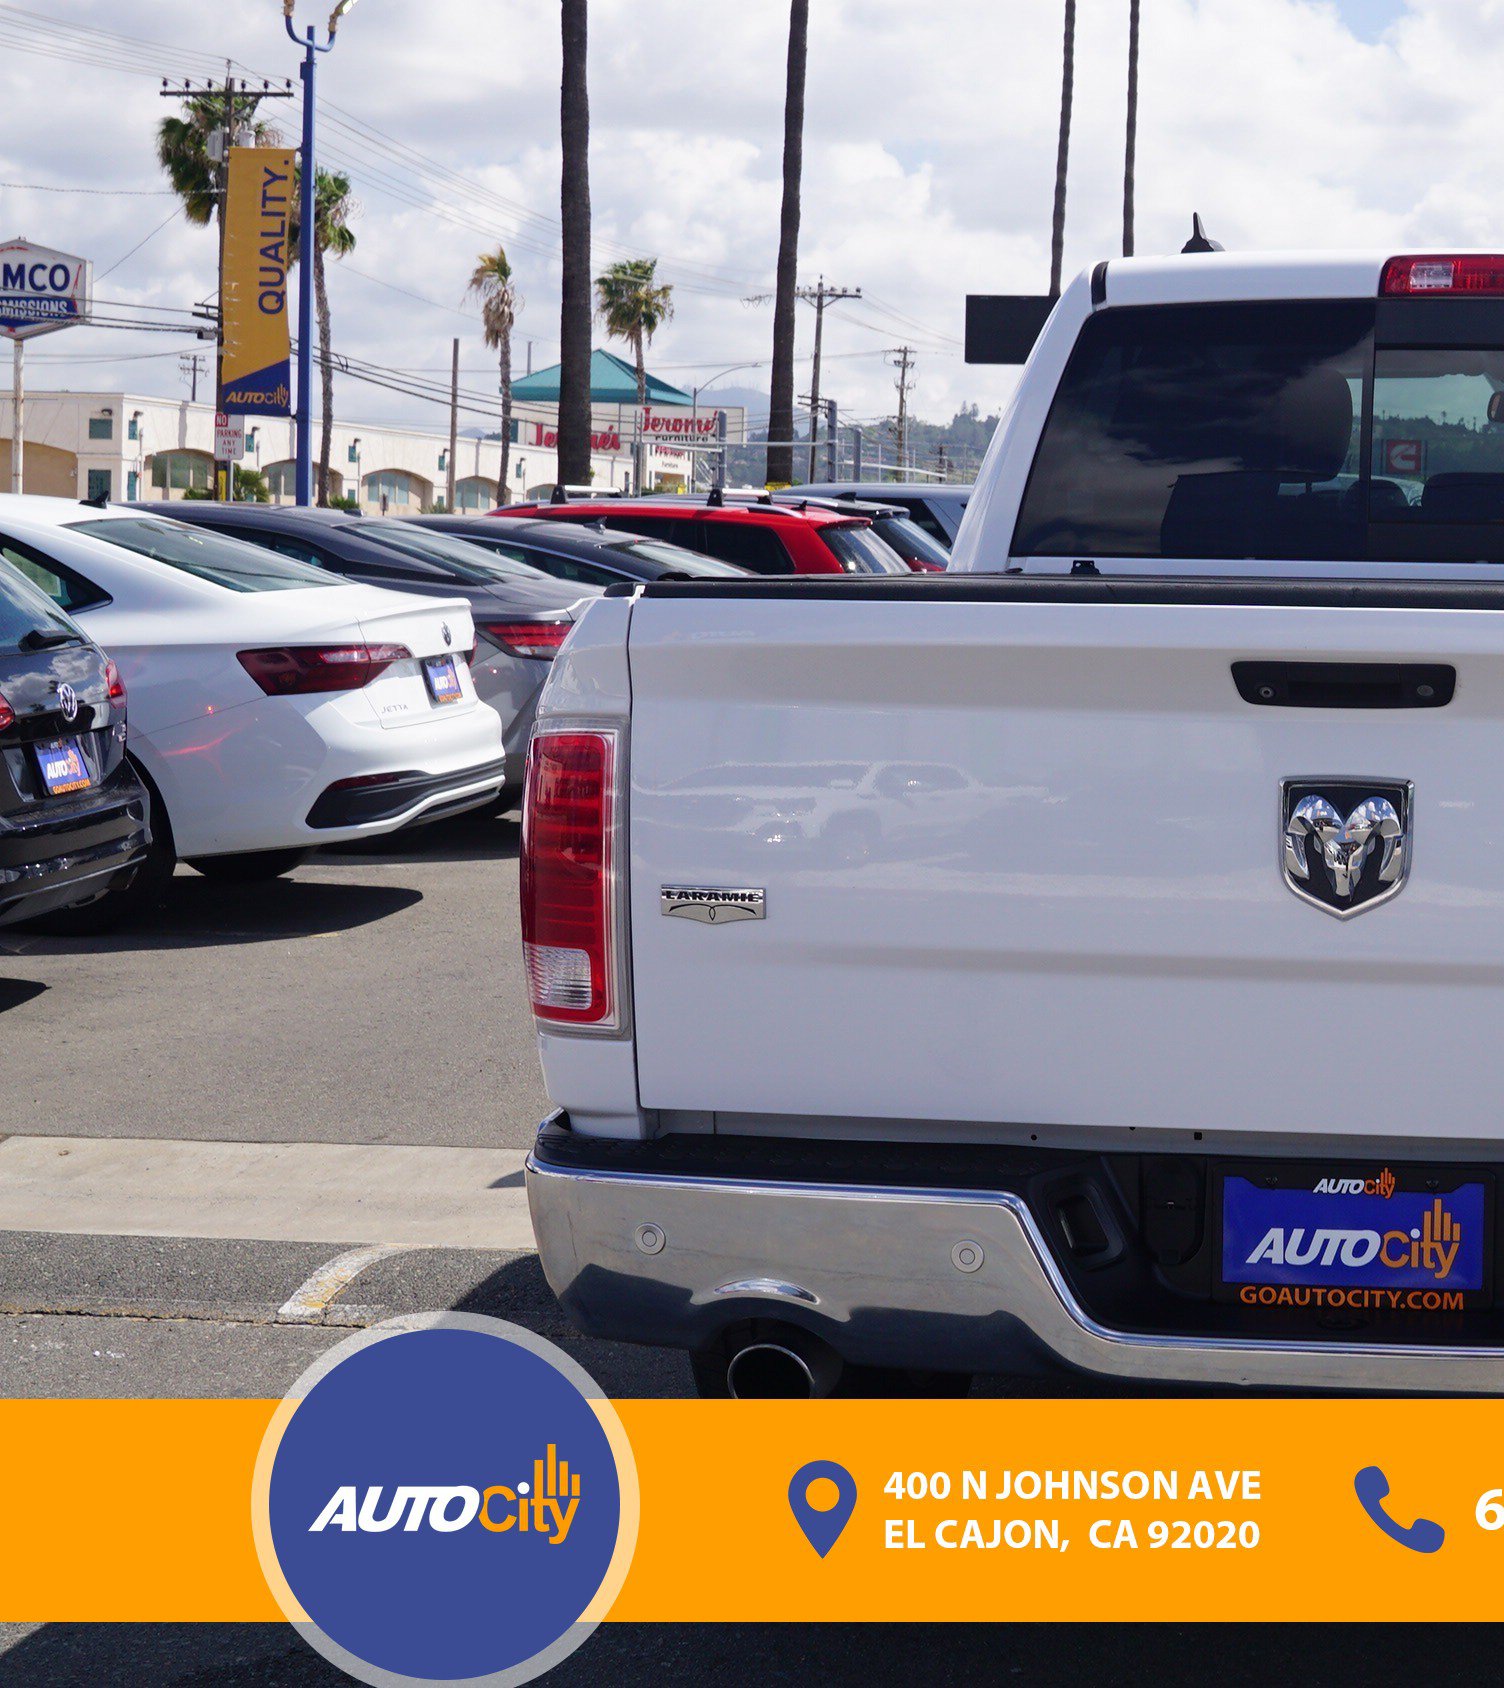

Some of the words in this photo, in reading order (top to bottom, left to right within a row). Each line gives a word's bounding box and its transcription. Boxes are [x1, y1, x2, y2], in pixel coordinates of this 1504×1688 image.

[258, 159, 290, 315] QUALITY.
[216, 415, 228, 427] NO
[382, 703, 409, 714] JETTA
[1240, 1285, 1464, 1311] GOAUTOCITY.COM
